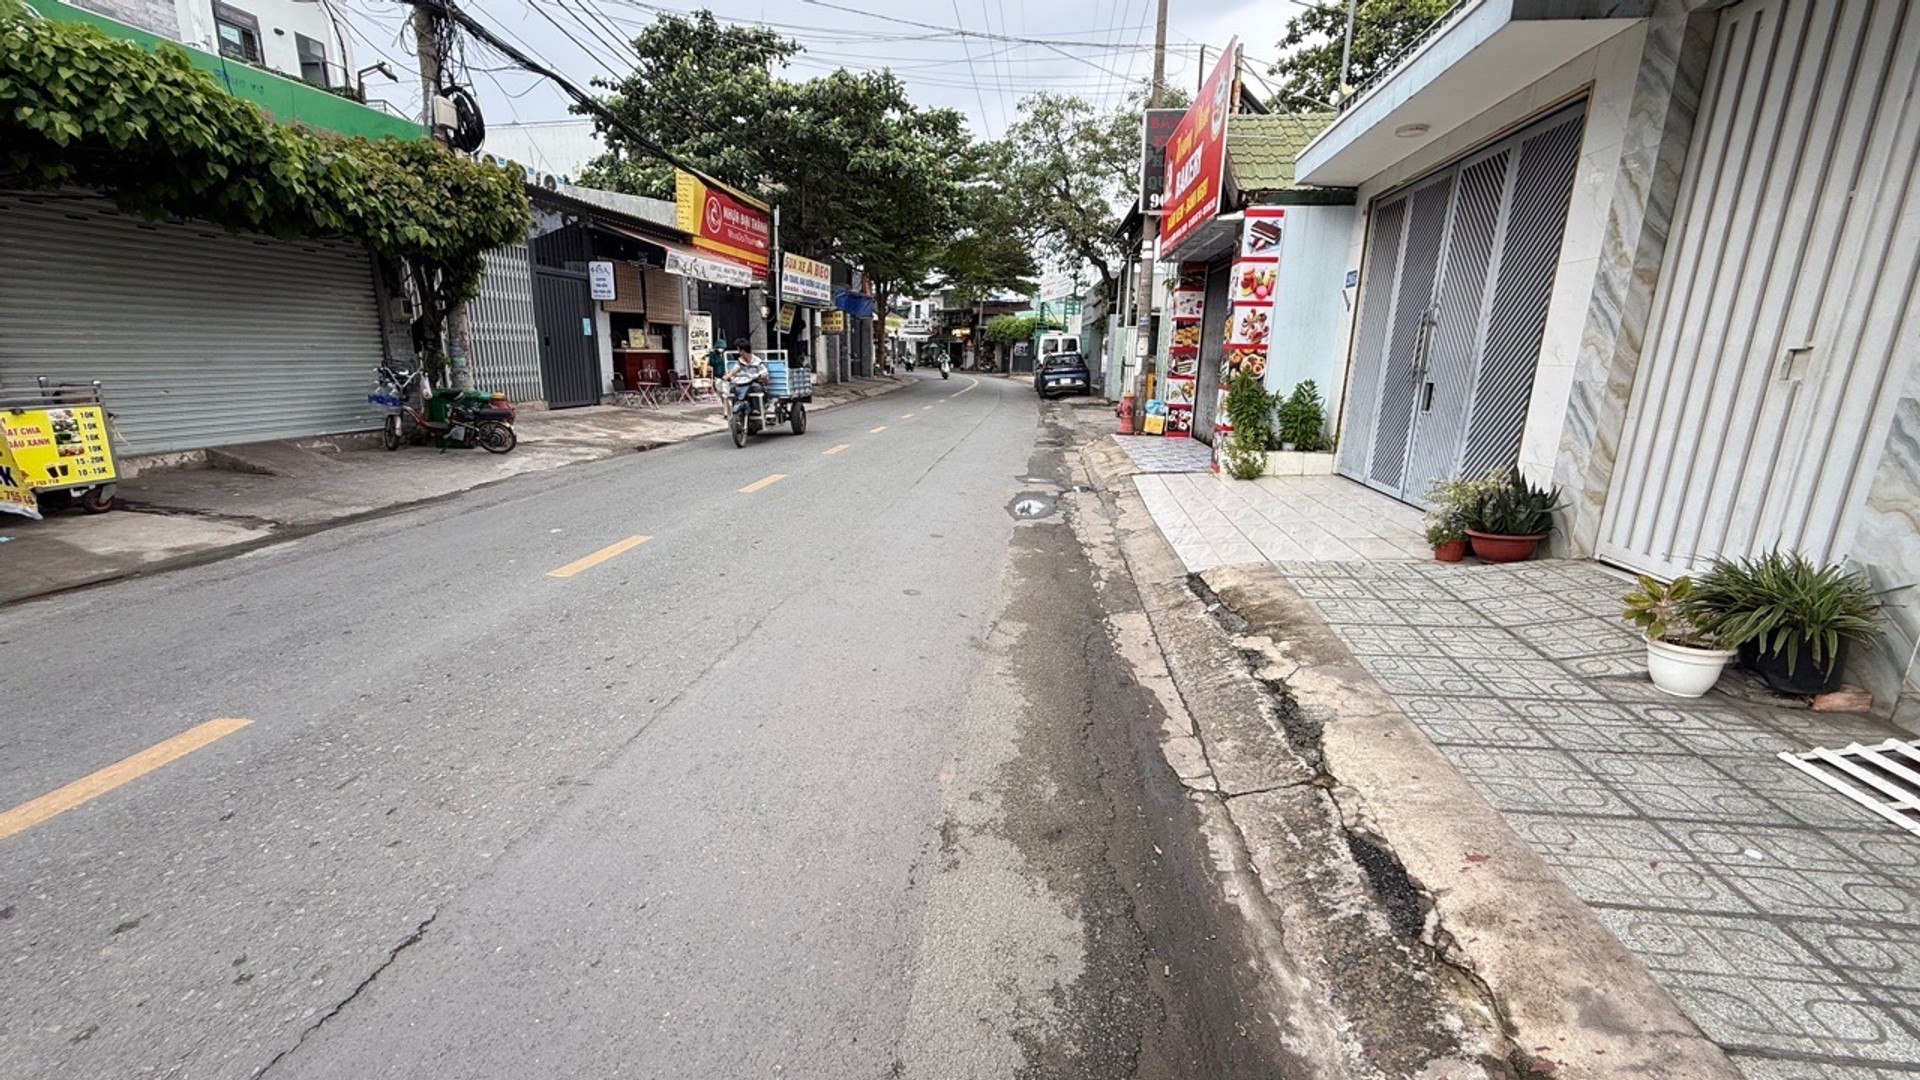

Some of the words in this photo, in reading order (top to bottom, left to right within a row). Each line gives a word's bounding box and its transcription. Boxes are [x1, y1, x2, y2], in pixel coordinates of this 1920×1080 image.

[1174, 140, 1204, 200] BAKERY
[80, 411, 95, 419] 10K
[83, 422, 98, 430] 10K
[85, 433, 100, 441] 10K
[88, 444, 103, 452] 10K
